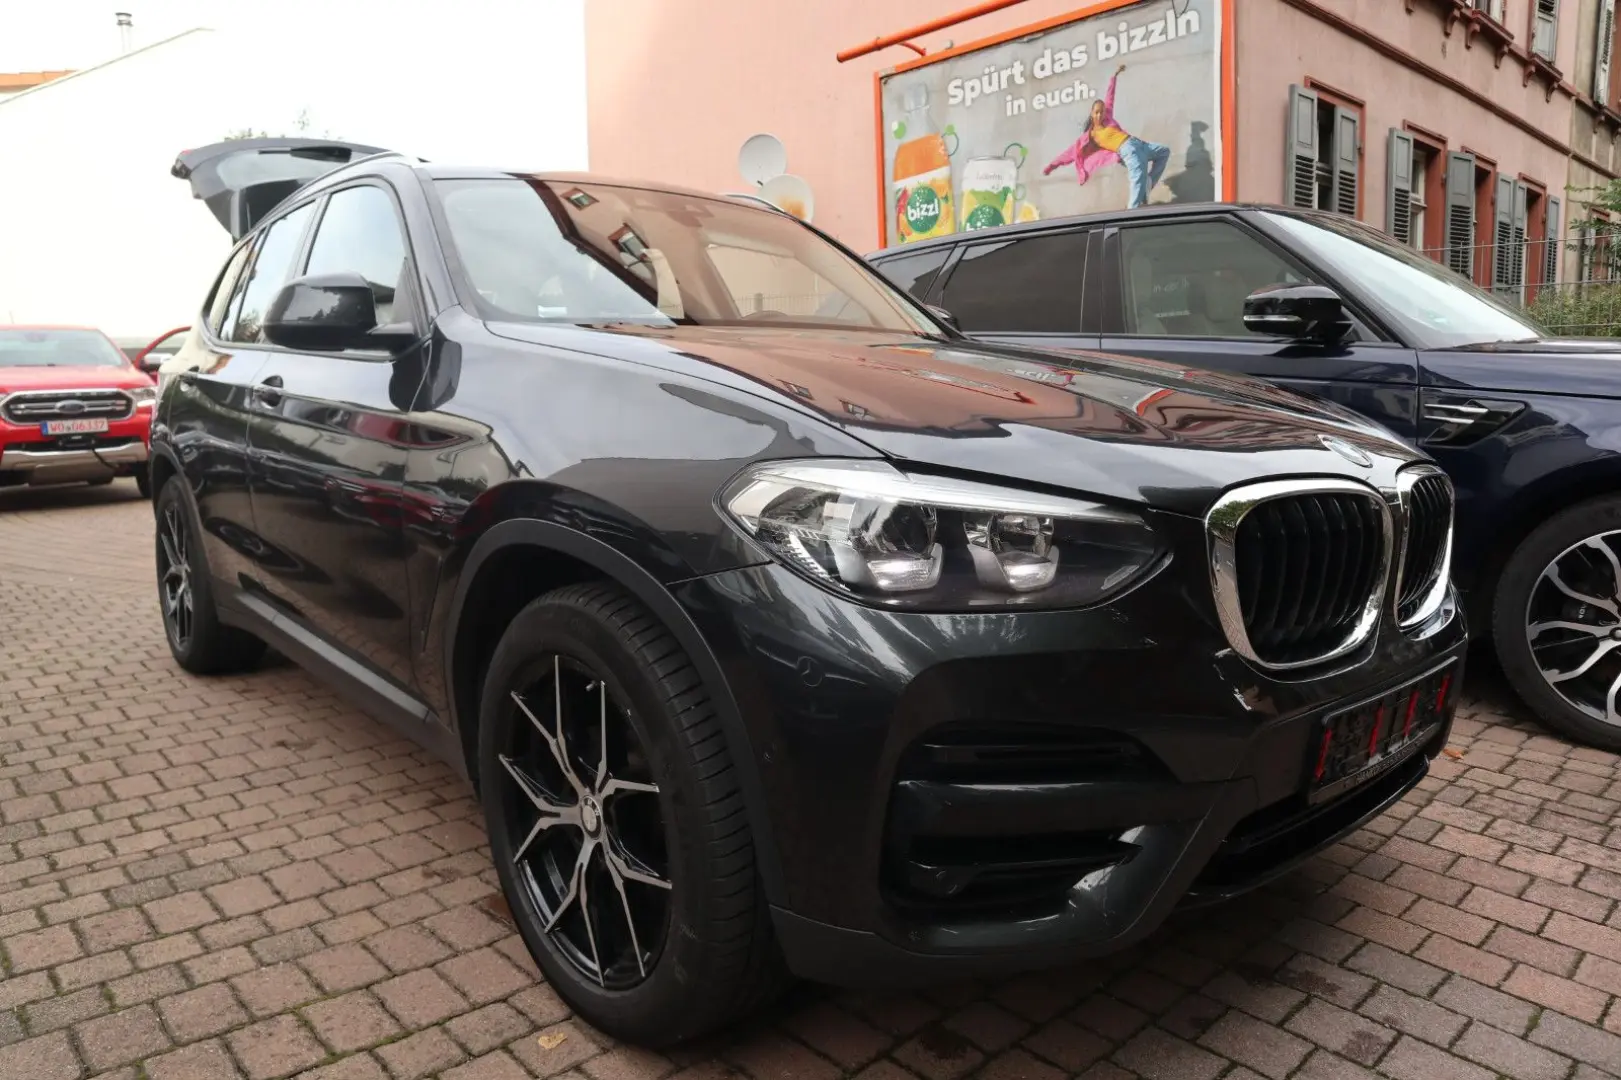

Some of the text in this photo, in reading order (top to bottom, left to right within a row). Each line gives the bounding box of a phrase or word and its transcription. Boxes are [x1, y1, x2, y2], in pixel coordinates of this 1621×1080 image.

[947, 8, 1200, 107] Spürt das bizzln
[1005, 79, 1096, 117] in euch.
[907, 198, 939, 221] bizzl
